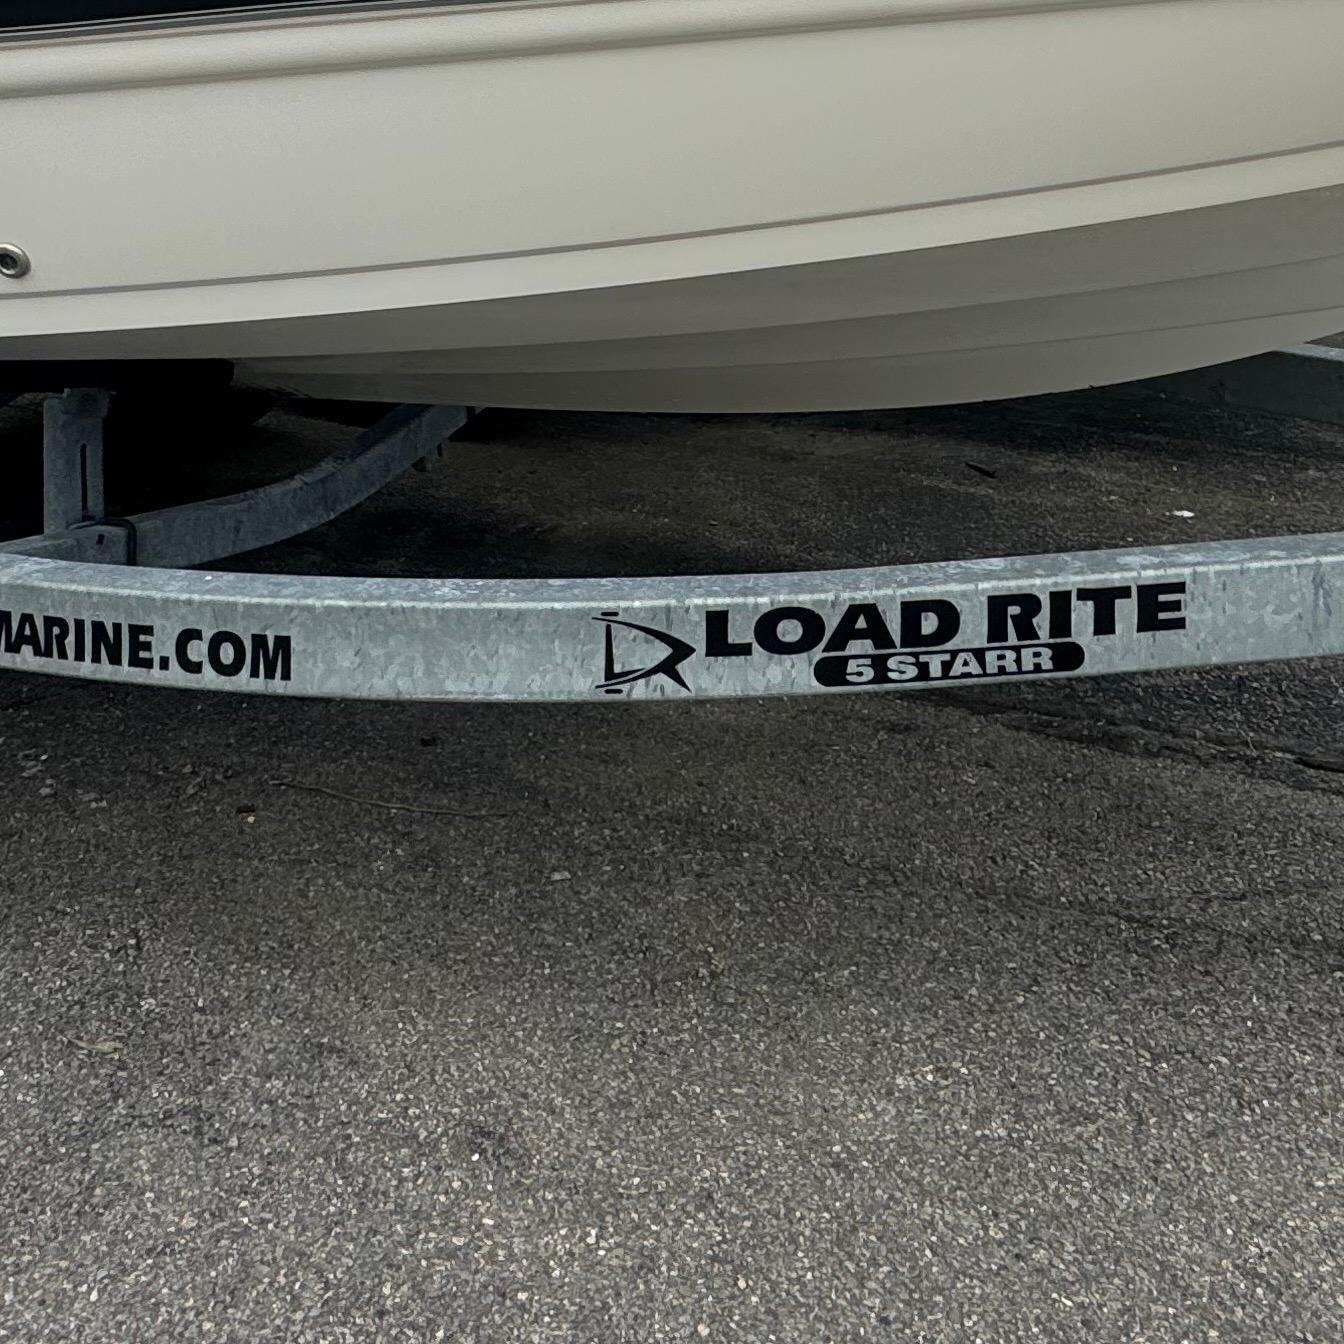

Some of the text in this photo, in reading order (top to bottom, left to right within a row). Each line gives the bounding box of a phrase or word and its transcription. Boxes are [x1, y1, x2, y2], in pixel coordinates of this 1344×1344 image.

[704, 581, 1187, 658] LOAD RITE
[845, 646, 1054, 683] 5 STARR
